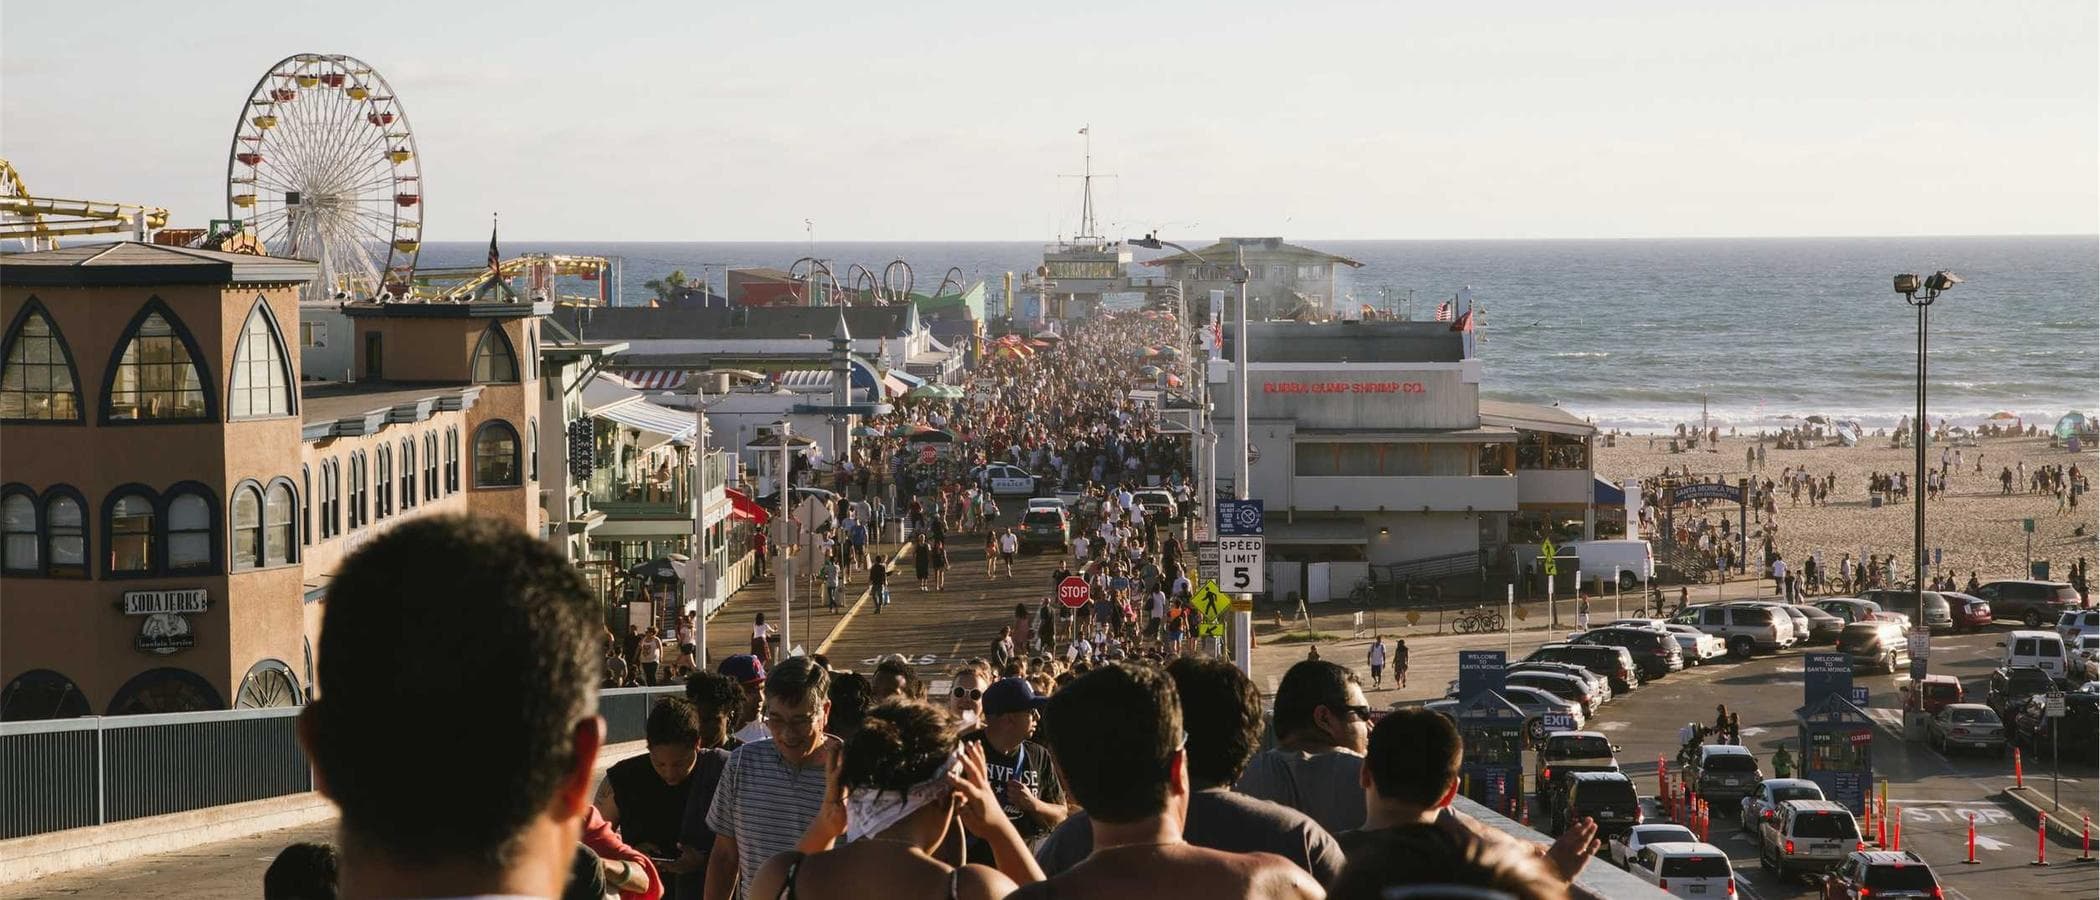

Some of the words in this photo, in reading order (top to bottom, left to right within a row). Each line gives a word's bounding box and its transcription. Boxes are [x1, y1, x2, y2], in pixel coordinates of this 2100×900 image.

[1351, 382, 1400, 393] SHRIMP
[1221, 540, 1262, 551] SPEED
[1225, 555, 1257, 563] LIMIT
[1234, 567, 1250, 588] 5
[1060, 586, 1088, 598] STOP
[132, 594, 161, 612] SODA
[164, 592, 199, 611] JERKS
[1543, 715, 1571, 726] EXIT
[1851, 734, 1871, 742] CLOSED
[1902, 807, 2015, 824] STOP
